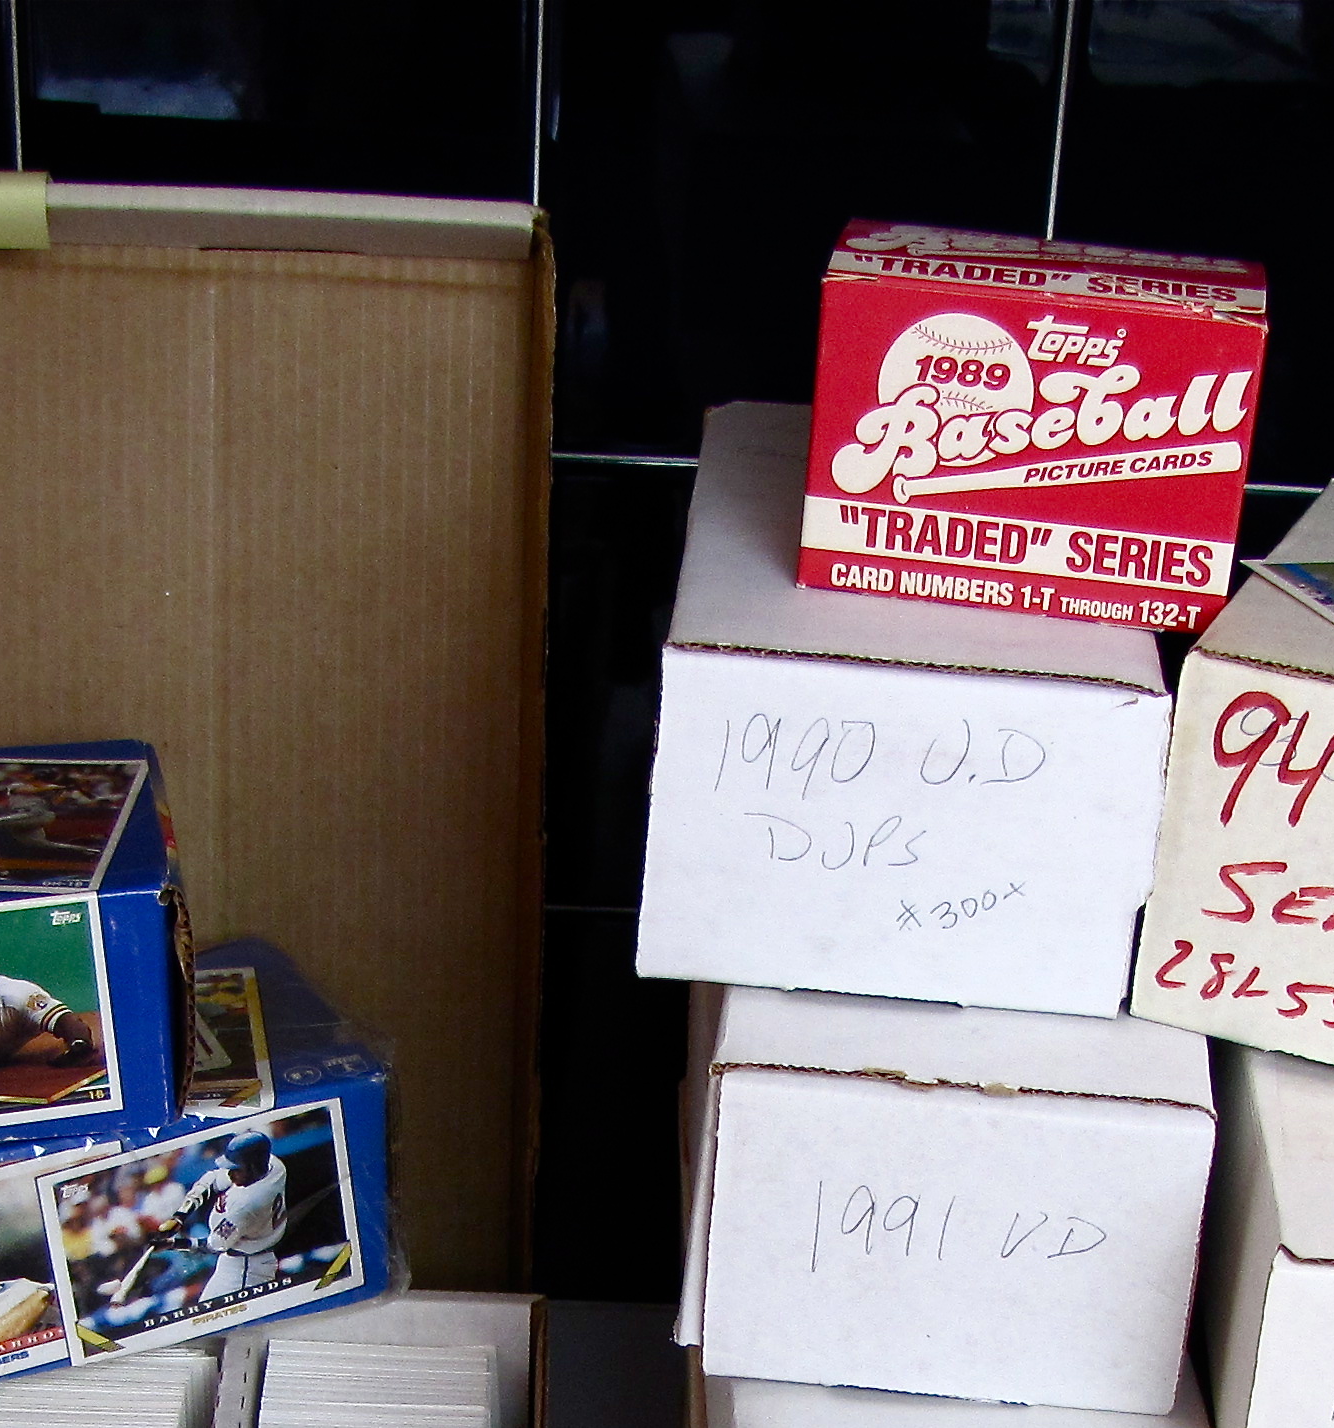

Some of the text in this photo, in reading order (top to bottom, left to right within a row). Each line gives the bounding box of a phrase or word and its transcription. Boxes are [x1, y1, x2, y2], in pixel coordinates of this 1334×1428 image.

[914, 355, 1011, 390] 1989
[831, 365, 1253, 494] Baseball
[1023, 451, 1213, 484] PICTURE CARDS
[1067, 531, 1213, 587] SERIES
[830, 564, 1201, 630] CARD NUMBERS 1-T THROUGH 132-T
[713, 713, 876, 800] 1990
[811, 1180, 958, 1273] 1991
[143, 1276, 293, 1329] BARRY BONDS
